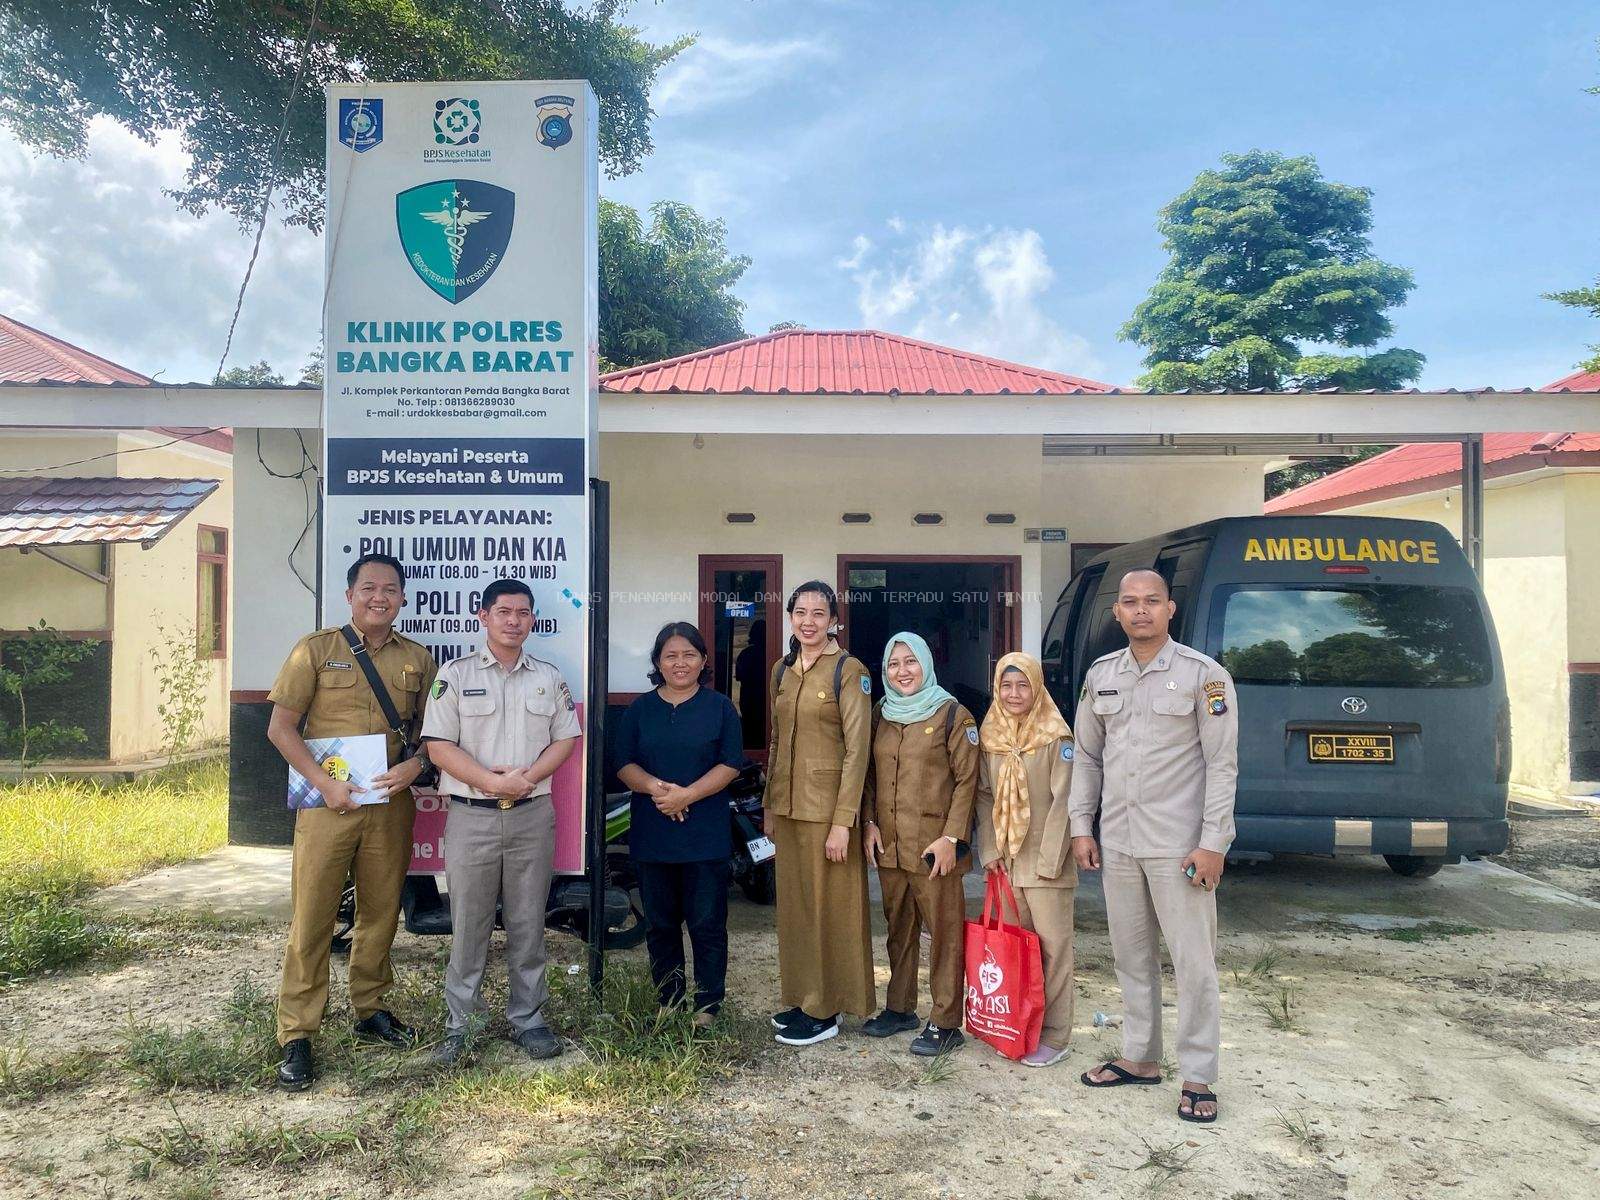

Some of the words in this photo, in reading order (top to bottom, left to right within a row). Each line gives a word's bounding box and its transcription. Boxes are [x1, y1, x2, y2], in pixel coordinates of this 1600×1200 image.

[423, 149, 444, 158] BPJS
[445, 149, 491, 158] Kesehatan
[413, 252, 449, 286] KEDOKTERAN
[450, 279, 466, 287] DAN
[465, 252, 498, 285] KESEHATAN
[347, 321, 447, 343] KLINIK
[453, 321, 563, 343] POLRES
[336, 351, 466, 373] BANGKA
[472, 351, 574, 373] BARAT
[341, 387, 352, 396] Jl.
[354, 387, 397, 397] Komplek
[400, 387, 462, 396] Perkantoran
[464, 387, 499, 396] Pemda
[502, 387, 540, 397] Bangka
[542, 387, 570, 396] Barat
[397, 398, 413, 407] No.
[416, 398, 437, 408] Telp
[444, 398, 515, 407] 081366289030
[366, 408, 400, 418] E-mail
[407, 408, 547, 419] urdokkesbabar@gmail.com
[381, 448, 458, 467] Melayani
[463, 450, 529, 464] Peserta
[347, 470, 389, 484] BPJS
[394, 470, 485, 484] Kesehatan
[490, 470, 502, 484] &
[507, 470, 563, 484] Umum
[358, 510, 415, 525] JENIS
[419, 510, 552, 525] PELAYANAN:
[359, 537, 404, 561] POLI
[412, 537, 475, 561] UMUM
[484, 537, 524, 561] DAN
[533, 537, 567, 561] KIA
[1244, 538, 1440, 564] AMBULANCE
[440, 565, 479, 580] (08.00
[492, 566, 526, 579] 14.30
[530, 565, 557, 580] WIB)
[416, 591, 460, 615] POLI
[730, 609, 749, 617] OPEN
[400, 620, 437, 633] JUMAT
[441, 619, 480, 633] (09.00
[1347, 737, 1376, 746] XXVIII
[1342, 749, 1364, 757] 1702
[1373, 749, 1384, 757] 35
